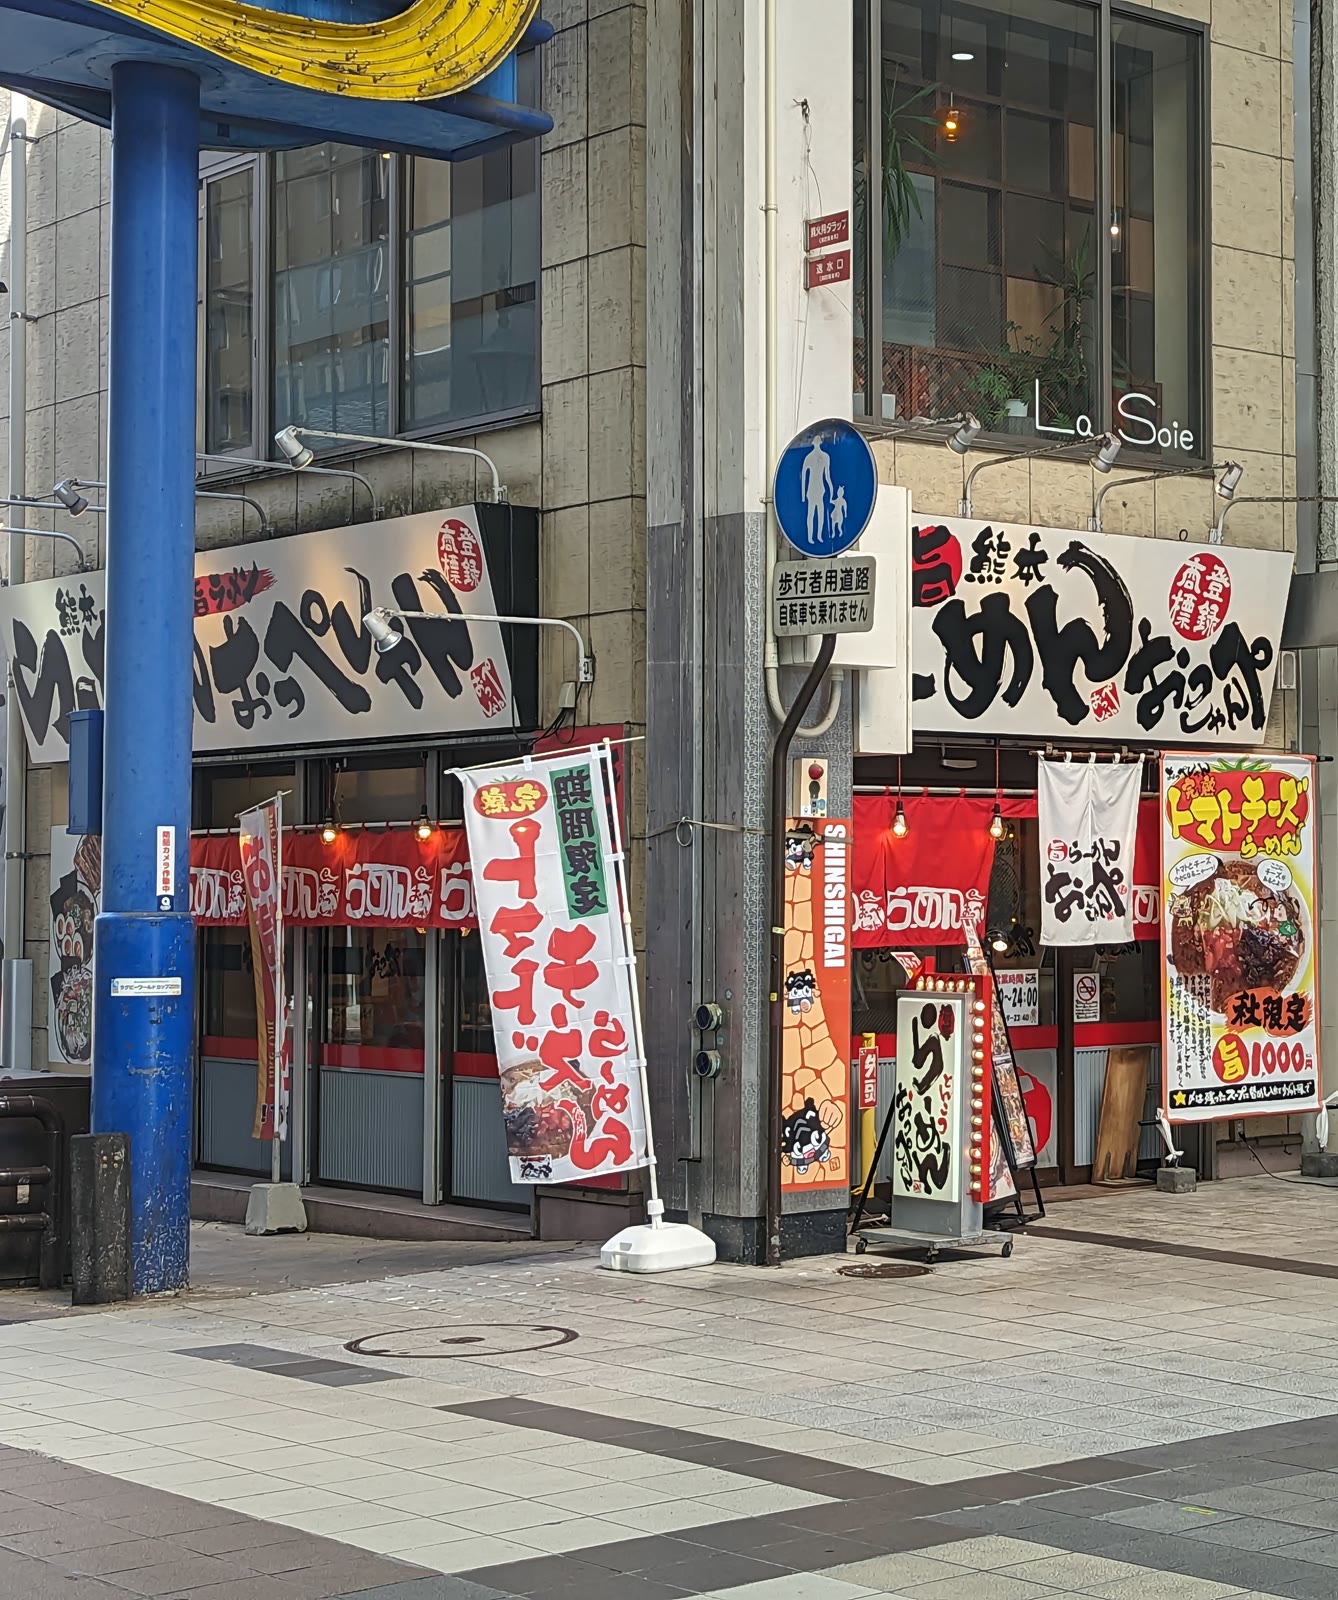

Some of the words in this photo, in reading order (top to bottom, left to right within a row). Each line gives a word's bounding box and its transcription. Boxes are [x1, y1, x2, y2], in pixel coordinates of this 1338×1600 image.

[1034, 378, 1095, 436] La
[1118, 393, 1194, 451] Soie
[964, 525, 1049, 585] 熊本
[779, 567, 870, 596] 歩行者用道路
[55, 584, 98, 636] 熊本
[780, 599, 868, 626] 自転車も乗れません
[1123, 617, 1273, 735] おっぺしゃん
[1167, 776, 1309, 844] トマトチーズ
[1182, 776, 1216, 800] 完熟
[1240, 822, 1305, 859] らーめん
[824, 824, 847, 968] SHINSHIGAI
[1231, 991, 1307, 1032] 秋限定
[1217, 1039, 1245, 1081] 旨
[912, 1002, 951, 1196] らーめん
